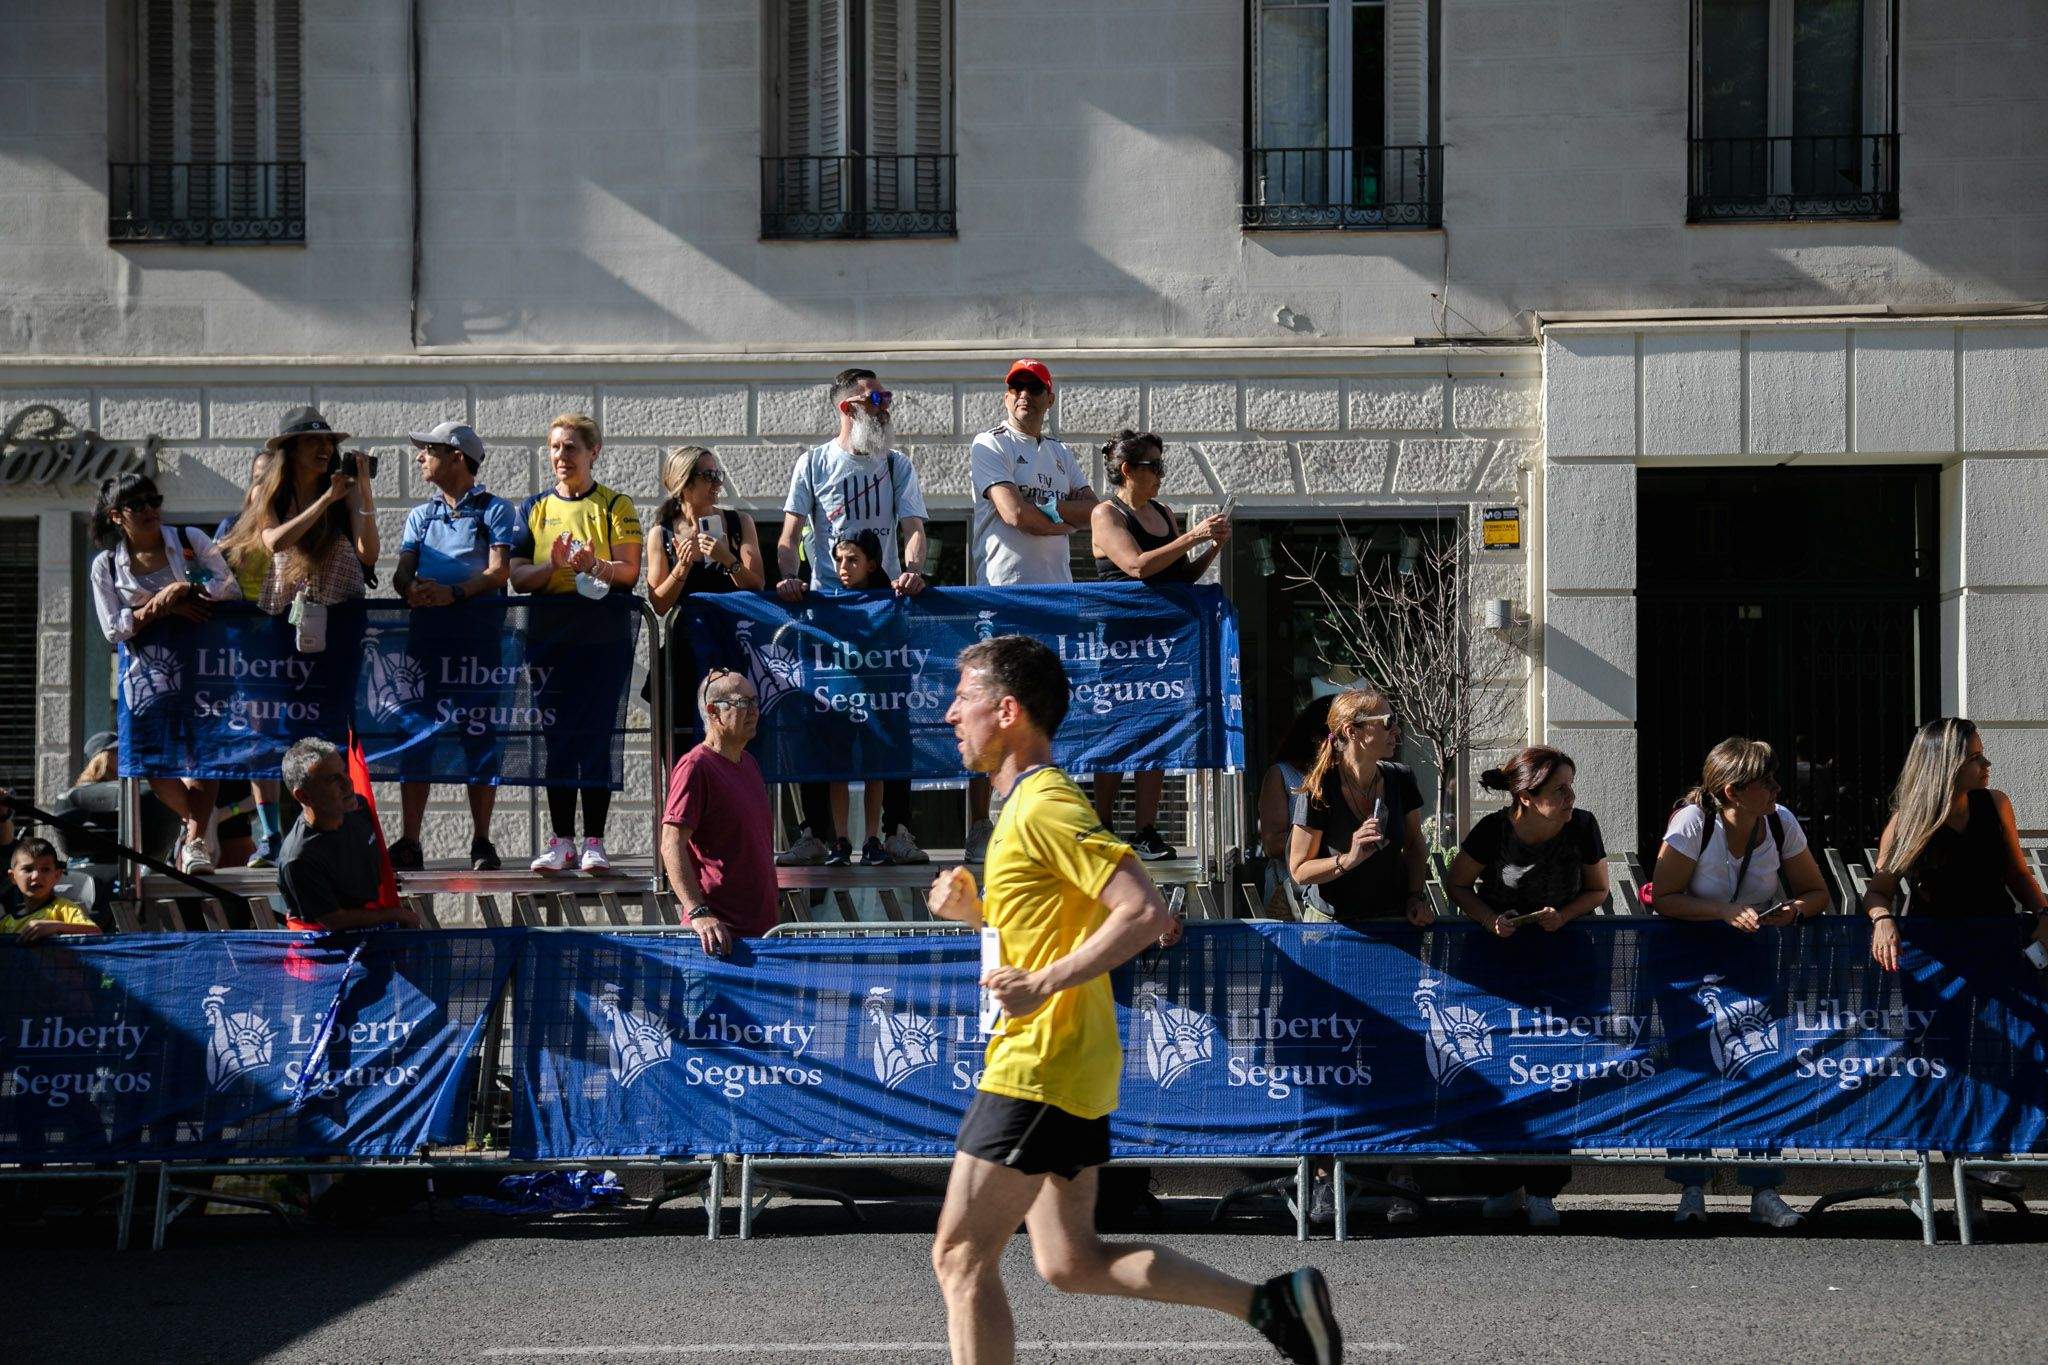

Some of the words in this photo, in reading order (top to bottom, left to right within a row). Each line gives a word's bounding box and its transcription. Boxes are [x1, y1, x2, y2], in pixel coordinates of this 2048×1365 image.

[196, 647, 317, 691] Liberty
[813, 640, 931, 680] Liberty
[1056, 631, 1177, 670] Liberty
[440, 656, 555, 697] Liberty
[194, 690, 320, 731] Seguros
[434, 698, 556, 736] Seguros
[814, 685, 940, 723] Seguros
[17, 1016, 150, 1060] Liberty
[688, 1013, 816, 1058] Liberty
[1225, 1007, 1363, 1053] Liberty
[1507, 1006, 1648, 1051] Liberty
[1794, 998, 1937, 1043] Liberty
[13, 1065, 152, 1107] Seguros
[685, 1057, 823, 1098] Seguros
[1228, 1056, 1372, 1100] Seguros
[1509, 1054, 1656, 1093] Seguros
[1796, 1047, 1948, 1091] Seguros
